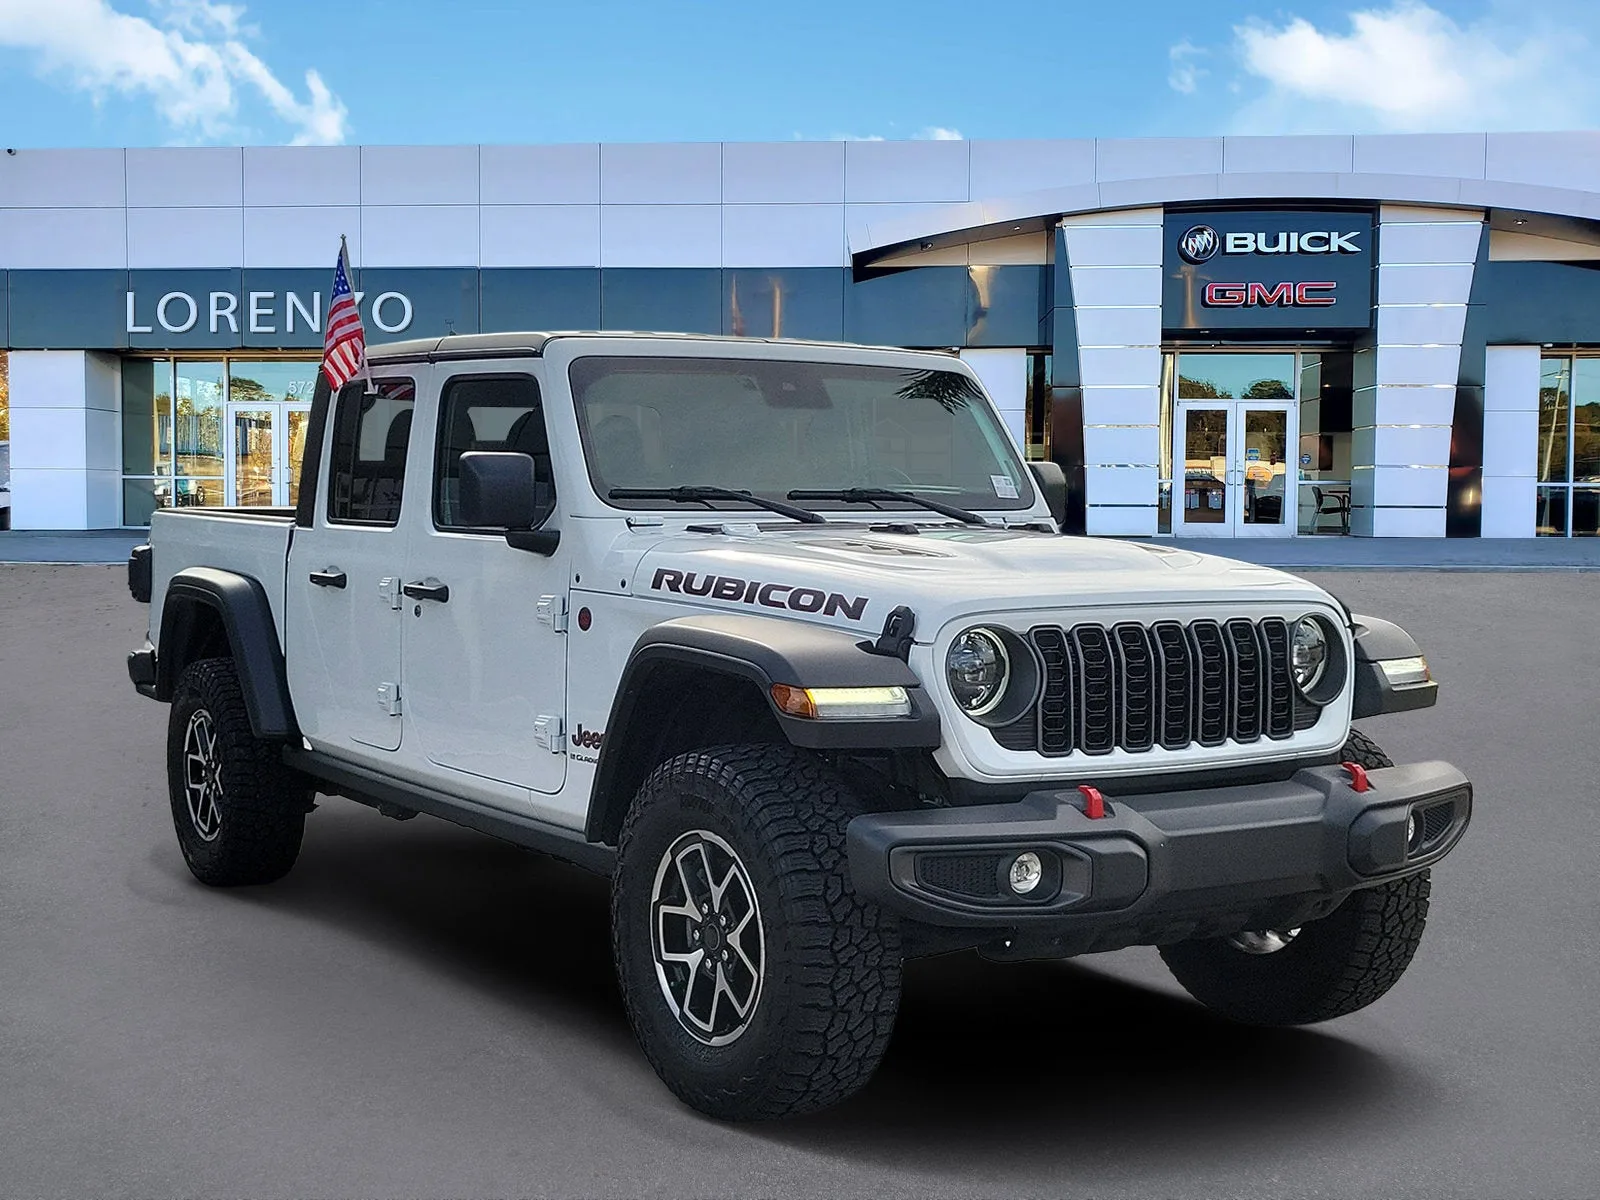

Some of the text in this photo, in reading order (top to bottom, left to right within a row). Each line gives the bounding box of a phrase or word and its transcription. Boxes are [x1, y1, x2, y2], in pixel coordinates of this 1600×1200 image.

[1225, 231, 1362, 253] BUICK
[1204, 281, 1337, 305] GMC
[126, 290, 414, 333] LORENO
[650, 567, 869, 621] RUBICON
[571, 723, 605, 750] Jee
